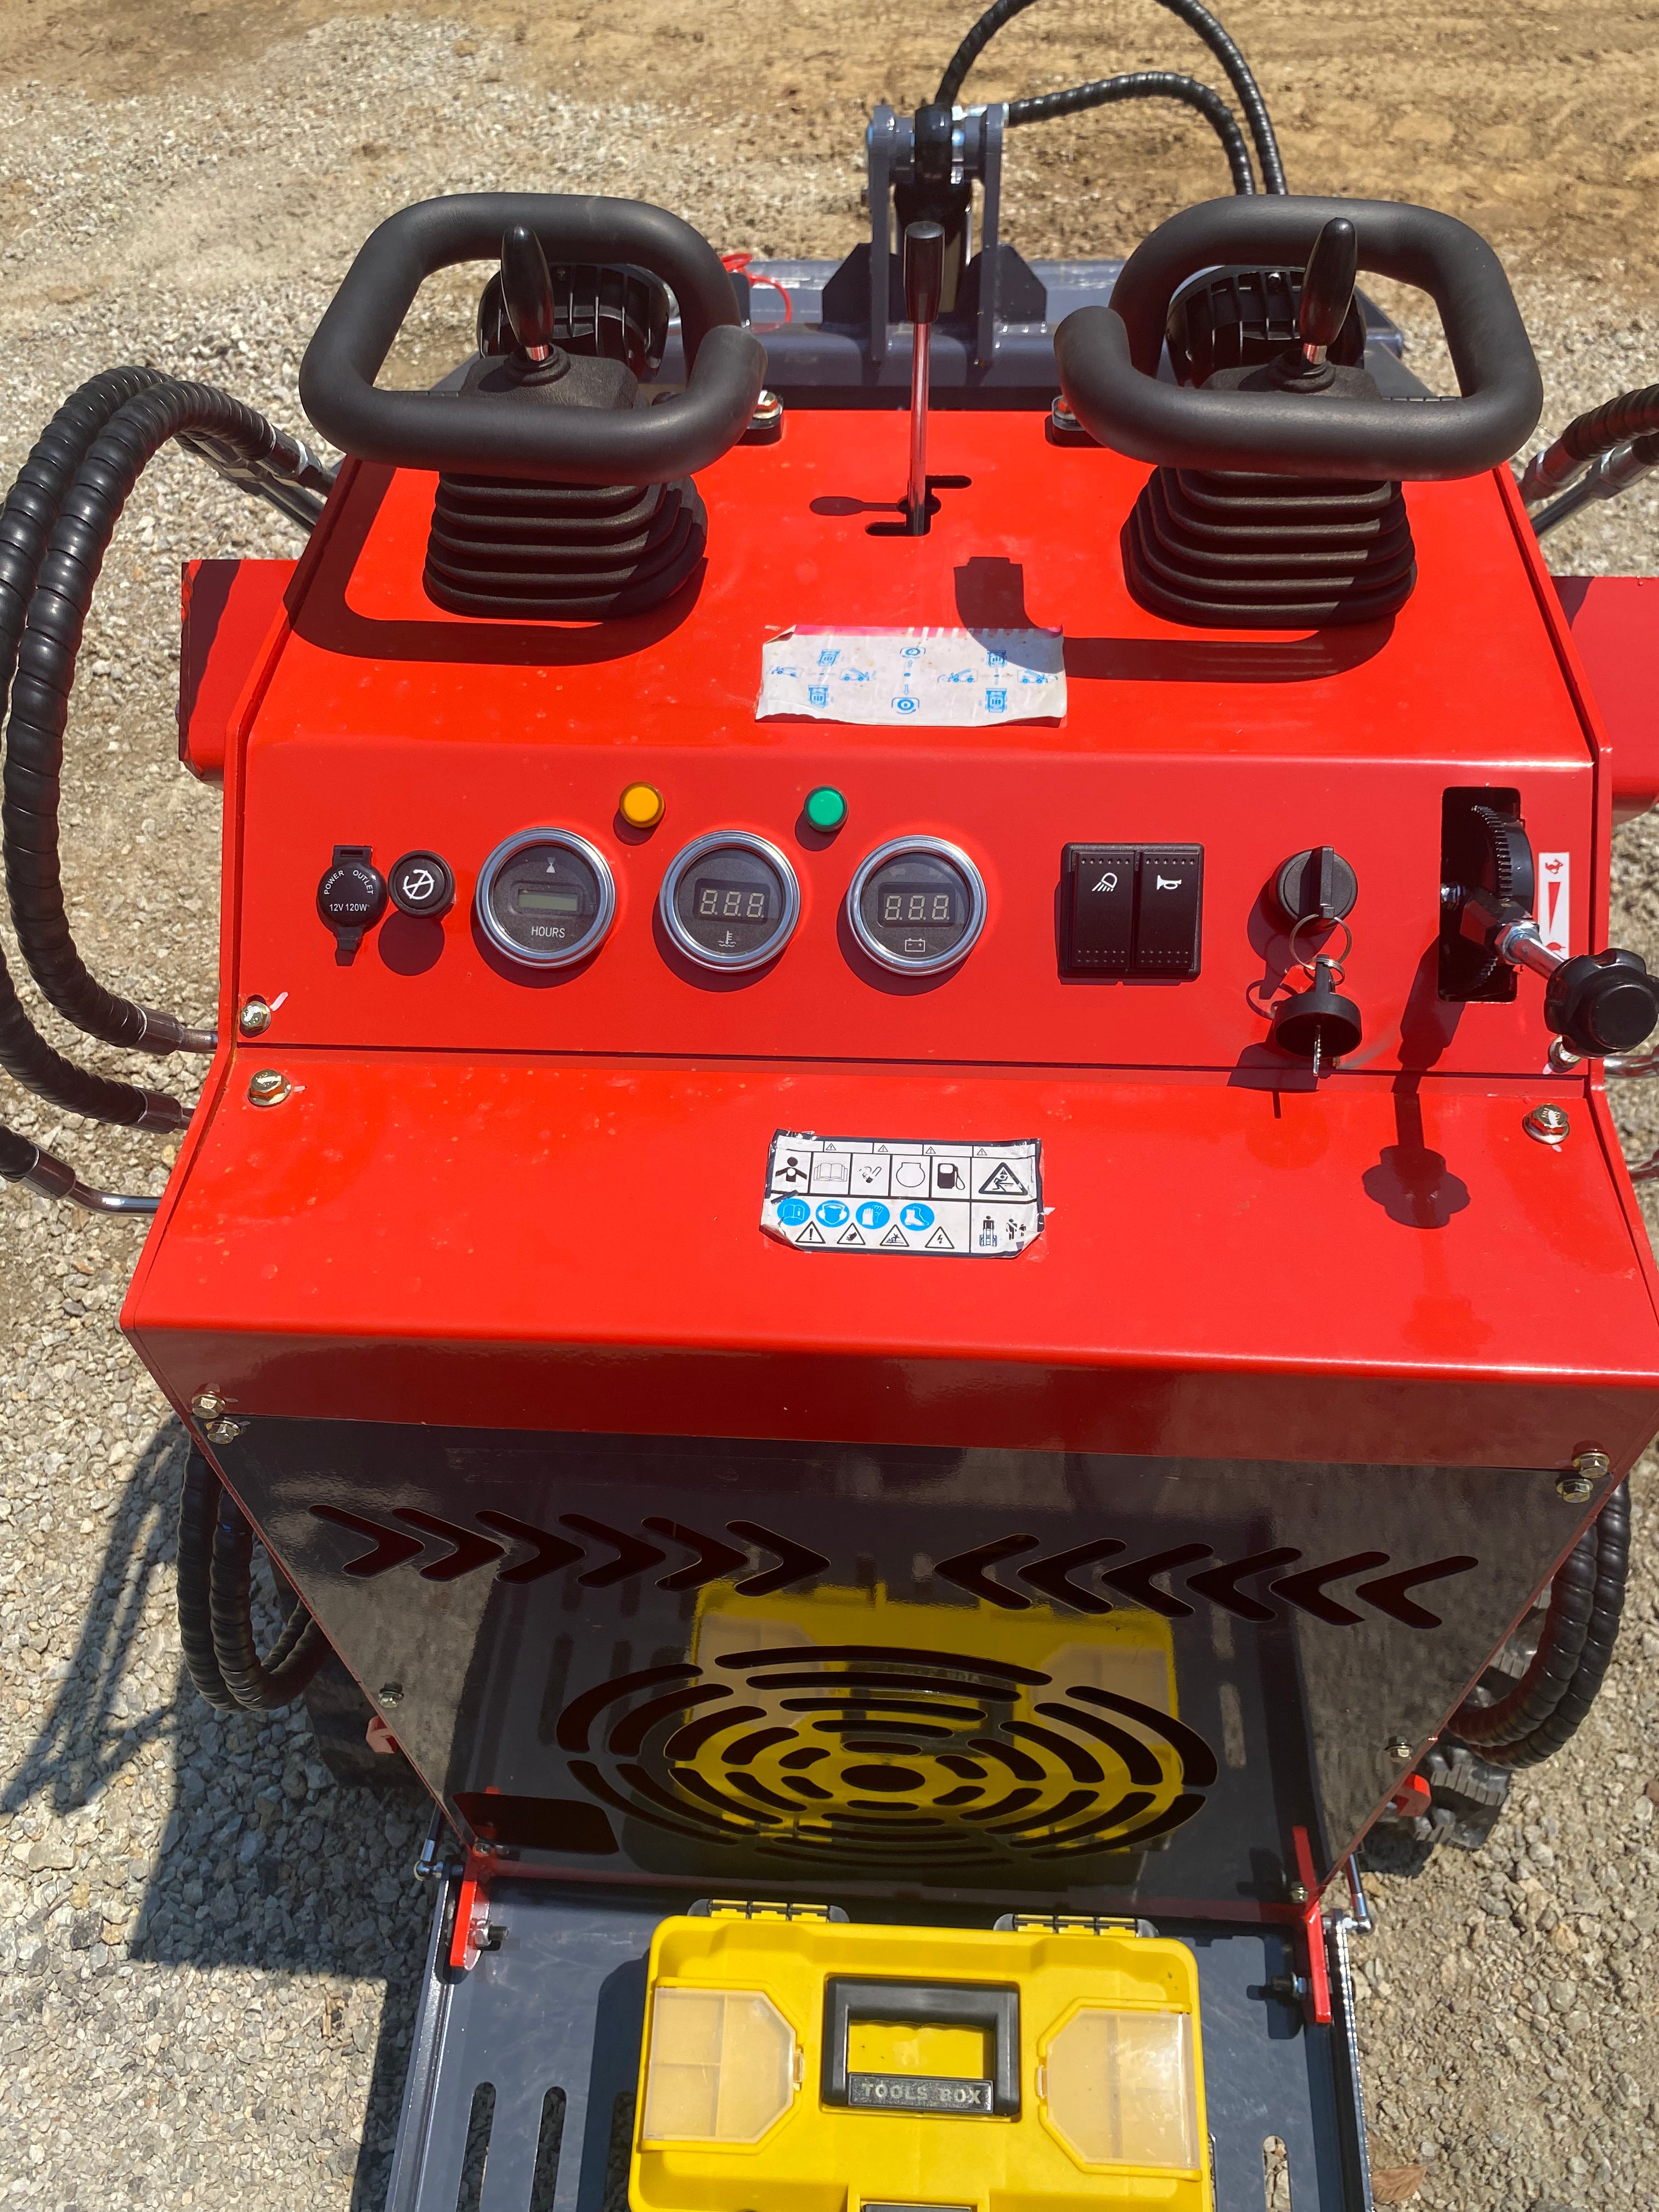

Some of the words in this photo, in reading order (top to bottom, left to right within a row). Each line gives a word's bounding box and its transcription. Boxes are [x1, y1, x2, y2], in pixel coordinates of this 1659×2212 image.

[324, 870, 345, 894] POWER
[353, 870, 374, 895] OUTLET
[532, 926, 566, 938] HOURS
[861, 2082, 928, 2101] TOOLS
[938, 2087, 981, 2104] BOX
